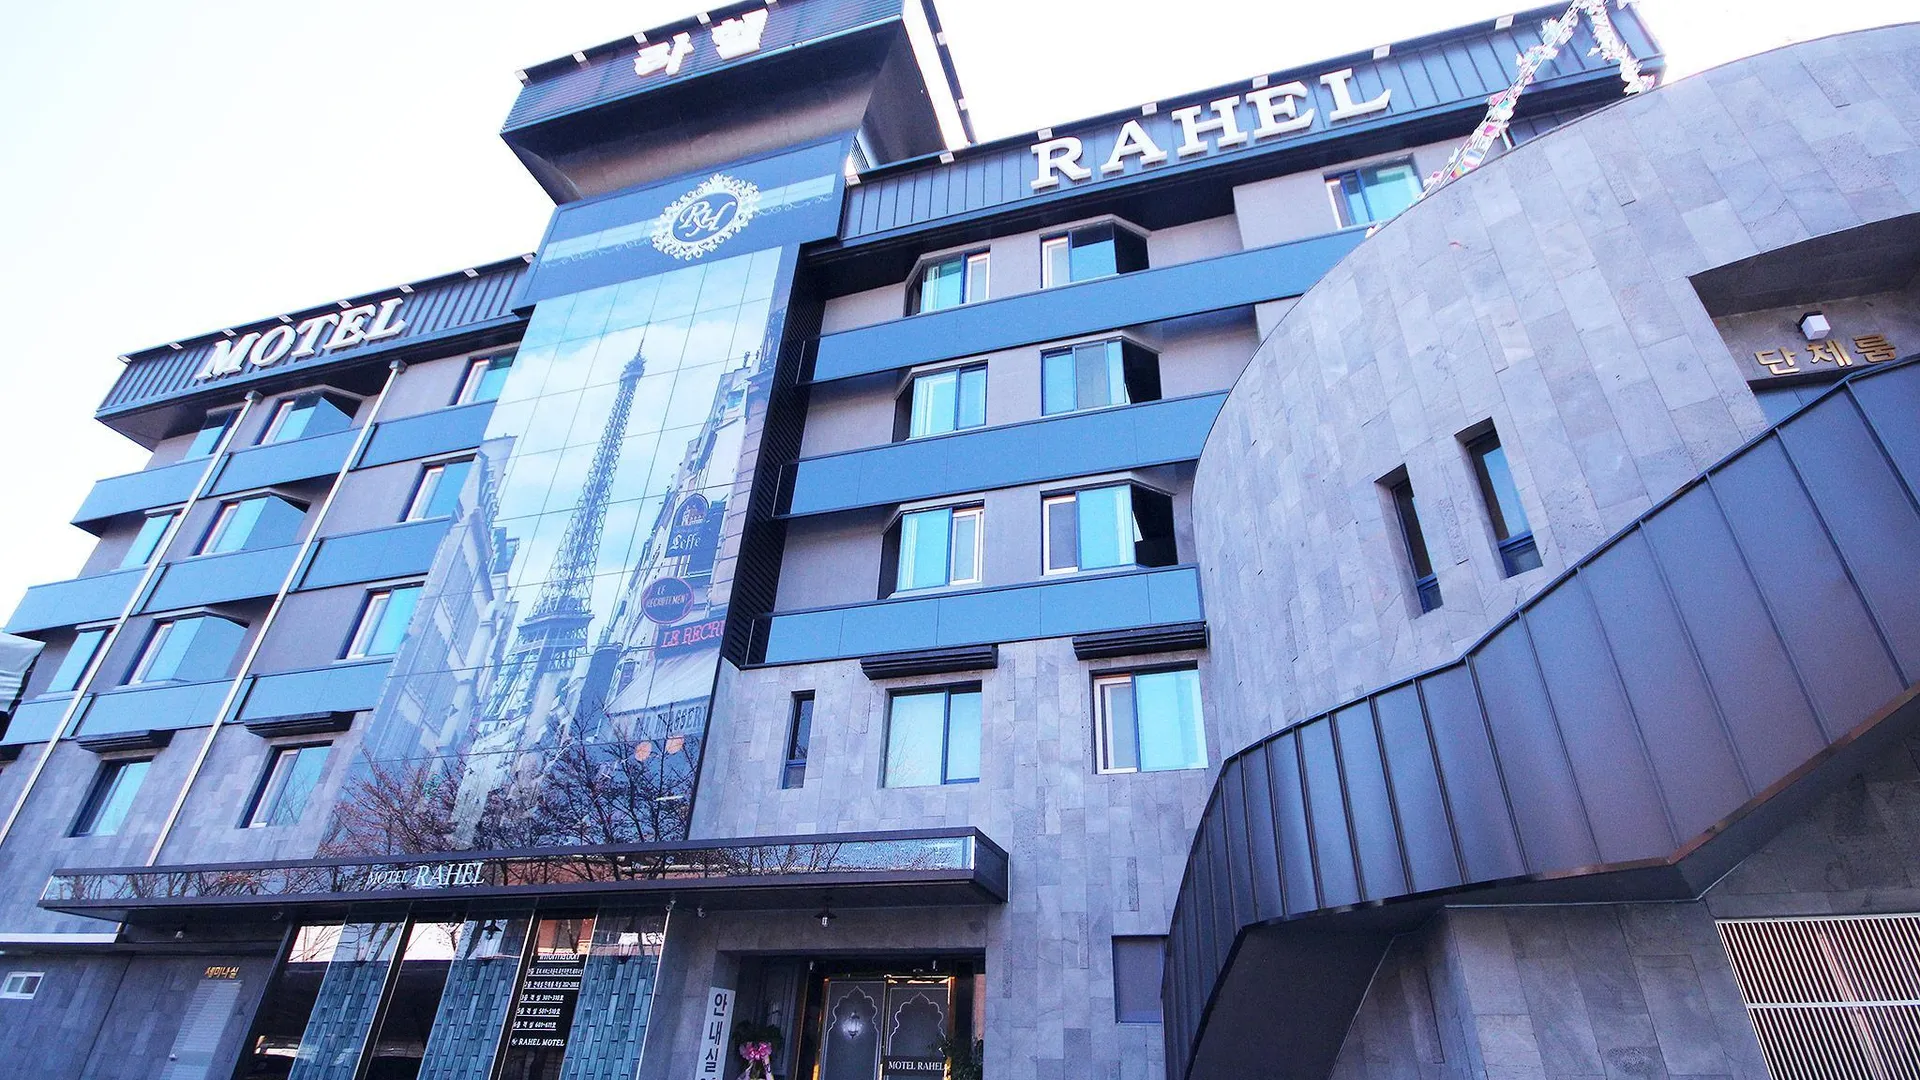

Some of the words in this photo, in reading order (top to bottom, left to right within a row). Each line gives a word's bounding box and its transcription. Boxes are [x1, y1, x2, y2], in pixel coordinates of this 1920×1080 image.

[1029, 67, 1392, 190] RAHEL
[195, 297, 408, 380] MOTEL
[366, 869, 408, 885] MOTEL
[412, 862, 485, 887] RAHEL
[518, 1038, 541, 1046] RAHEL
[541, 1038, 565, 1047] MOTEL
[705, 993, 727, 1073] 안내실
[888, 1060, 916, 1070] MOTEL
[917, 1061, 945, 1071] RAHEL
